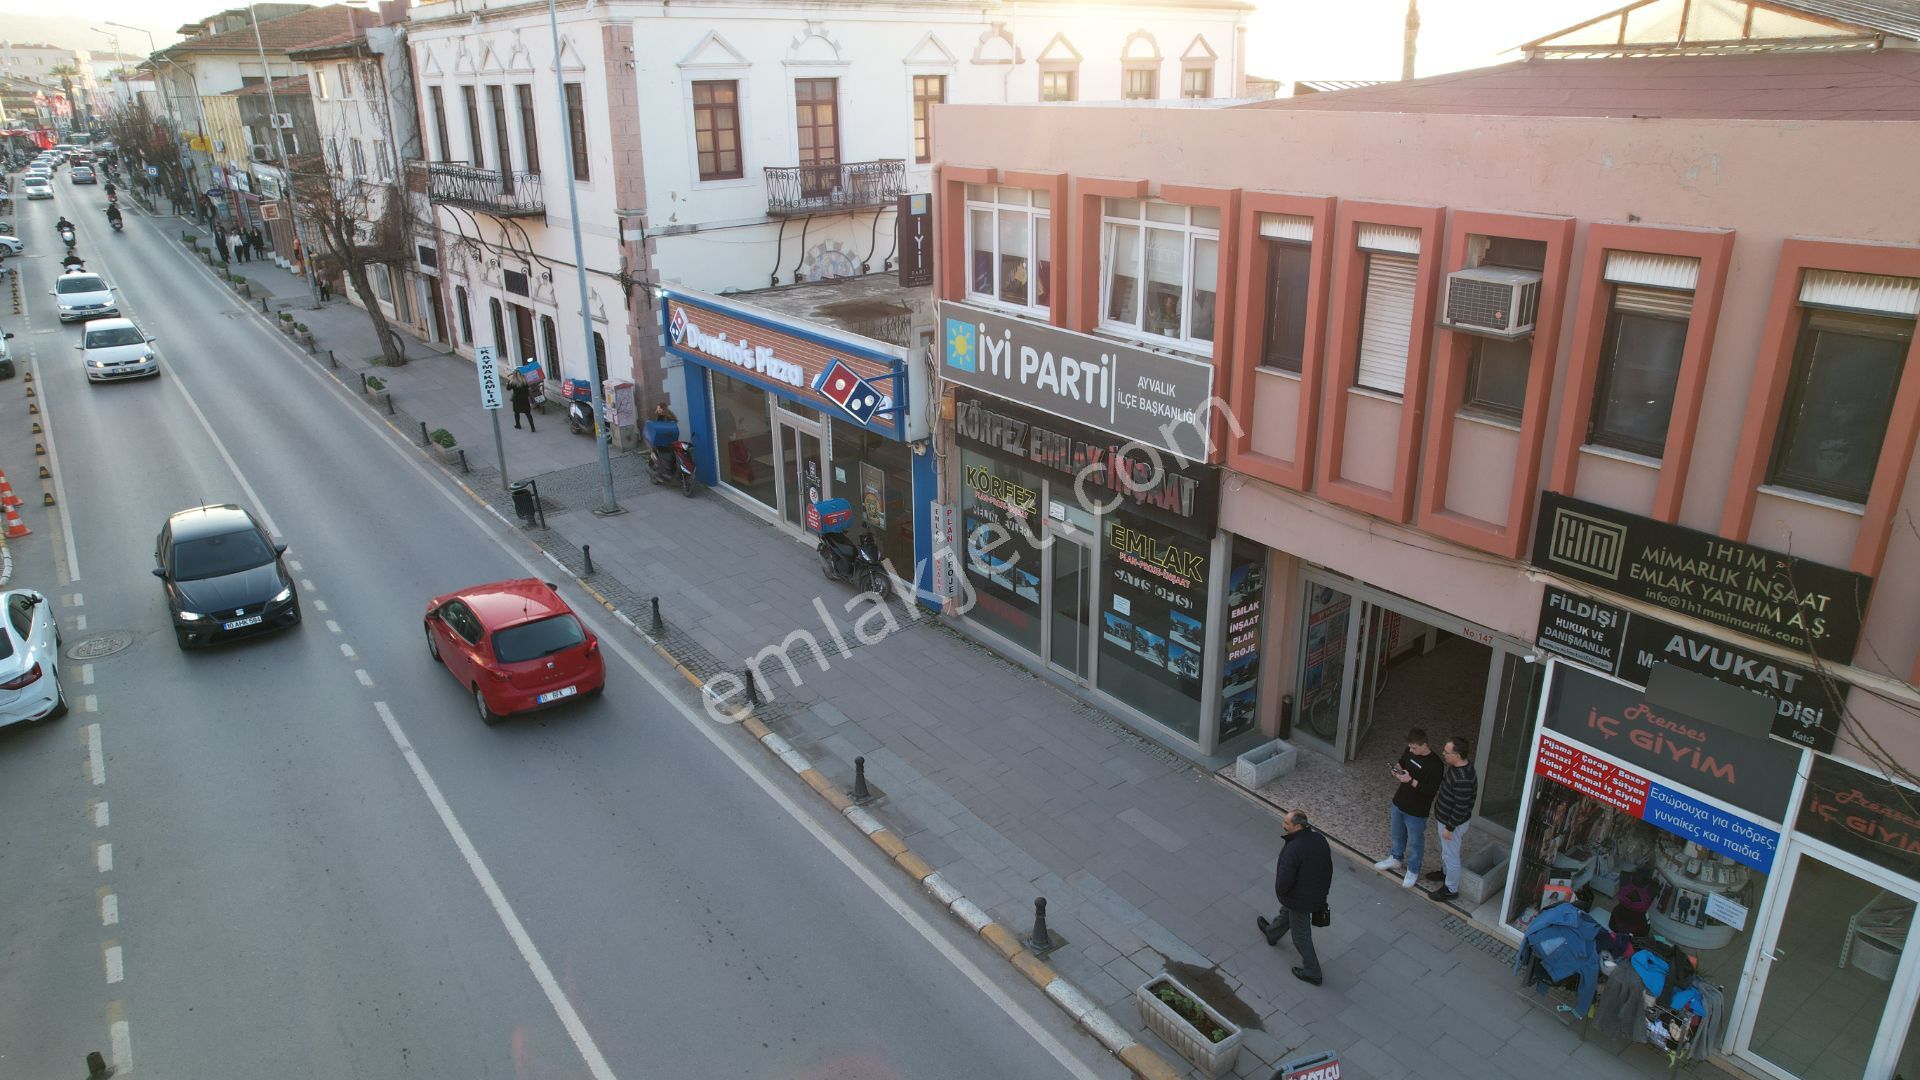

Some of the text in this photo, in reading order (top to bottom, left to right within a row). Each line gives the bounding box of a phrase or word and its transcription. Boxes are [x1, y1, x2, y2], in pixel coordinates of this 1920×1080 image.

[686, 322, 804, 388] Domino's Pizza
[978, 322, 1109, 409] İYİ PARTİ
[480, 349, 497, 404] KAYMAKAMLIK
[1137, 375, 1177, 398] AYVALIK
[1117, 388, 1196, 426] İLÇE BAŞKANLIĞI
[956, 399, 1029, 457] KÖRFEZ
[1031, 426, 1105, 486] EMLAK
[965, 464, 1037, 515] KÖRFEZ
[946, 509, 954, 543] PLAN
[1110, 522, 1205, 583] EMLAK
[1706, 541, 1767, 573] 1H1M
[1629, 562, 1696, 596] EMLAK
[1700, 583, 1783, 623] YATIRIM
[1641, 545, 1832, 613] MİMARLIK İNŞAAT
[1229, 614, 1260, 634] İNŞAAT
[1231, 600, 1261, 619] EMLAK
[1549, 593, 1618, 629] FİLDİŞİ
[1555, 617, 1605, 642] HUKUK VE
[1645, 587, 1805, 647] info@1h1mmimarlik.com
[1229, 643, 1256, 661] PROJE
[1232, 630, 1255, 646] PLAN
[1544, 626, 1612, 658] DANIŞMANLIK
[1664, 634, 1803, 694] AVUKAT
[1623, 703, 1708, 743] Prenses
[1543, 738, 1573, 756] Pijama
[1581, 754, 1609, 772] Çorap
[1618, 769, 1647, 786] Boxer
[1588, 706, 1735, 784] İÇ GİYİM
[1540, 747, 1572, 766] Fantazi
[1580, 764, 1603, 779] Atlet
[1612, 777, 1646, 797] Sütyen
[1546, 770, 1630, 811] Asker Malzemeleri
[1572, 770, 1602, 788] Termal
[1614, 789, 1642, 806] Giyim
[1650, 787, 1709, 820] Εσώρουχα
[1711, 814, 1729, 829] για
[1654, 808, 1702, 838] γυναίκες
[1702, 829, 1721, 843] και
